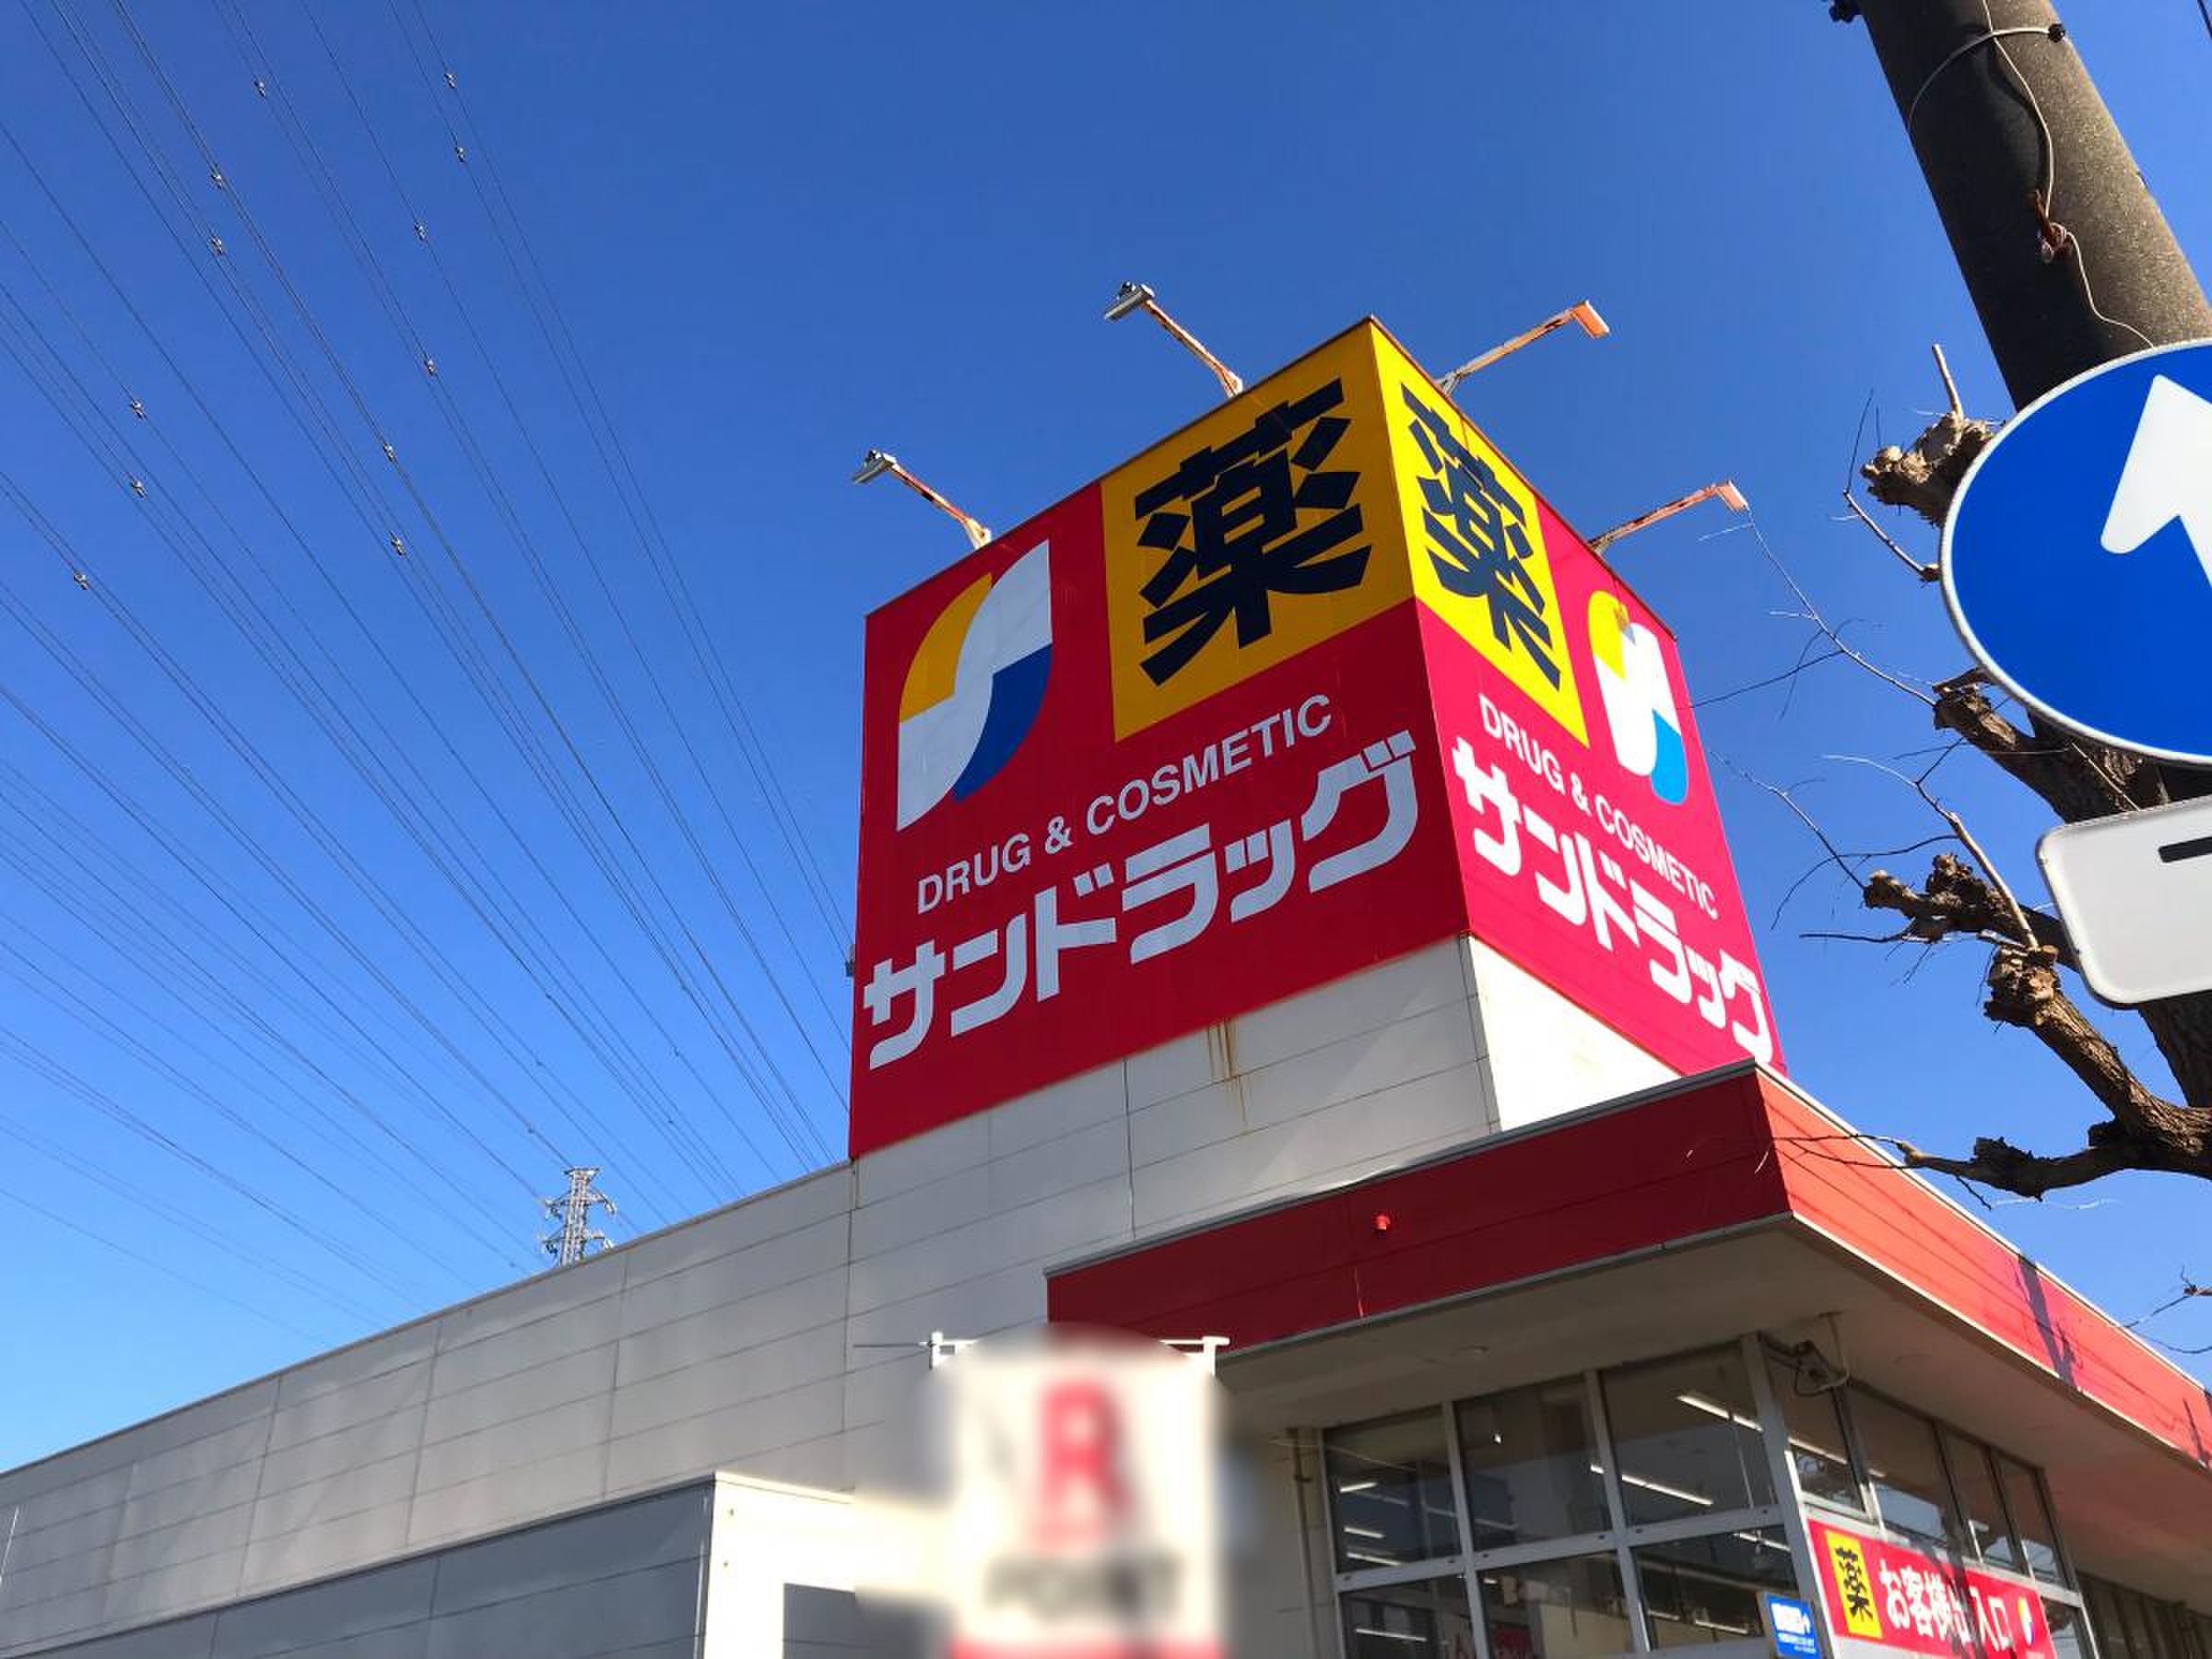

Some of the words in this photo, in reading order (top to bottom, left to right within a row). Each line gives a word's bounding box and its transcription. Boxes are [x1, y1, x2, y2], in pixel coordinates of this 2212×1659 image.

[1135, 379, 1372, 686] 薬
[1401, 382, 1560, 691] 薬
[863, 731, 1418, 1069] サンドラッグ
[917, 832, 1031, 914] DRUG
[1044, 816, 1075, 854] &
[1086, 693, 1332, 835] COSMETIC
[1453, 736, 1772, 1063] サンドラッグ
[1479, 693, 1565, 795] DRUG
[1570, 772, 1592, 816] &
[1594, 795, 1718, 920] COSMETIC
[1835, 1547, 1873, 1621] 薬
